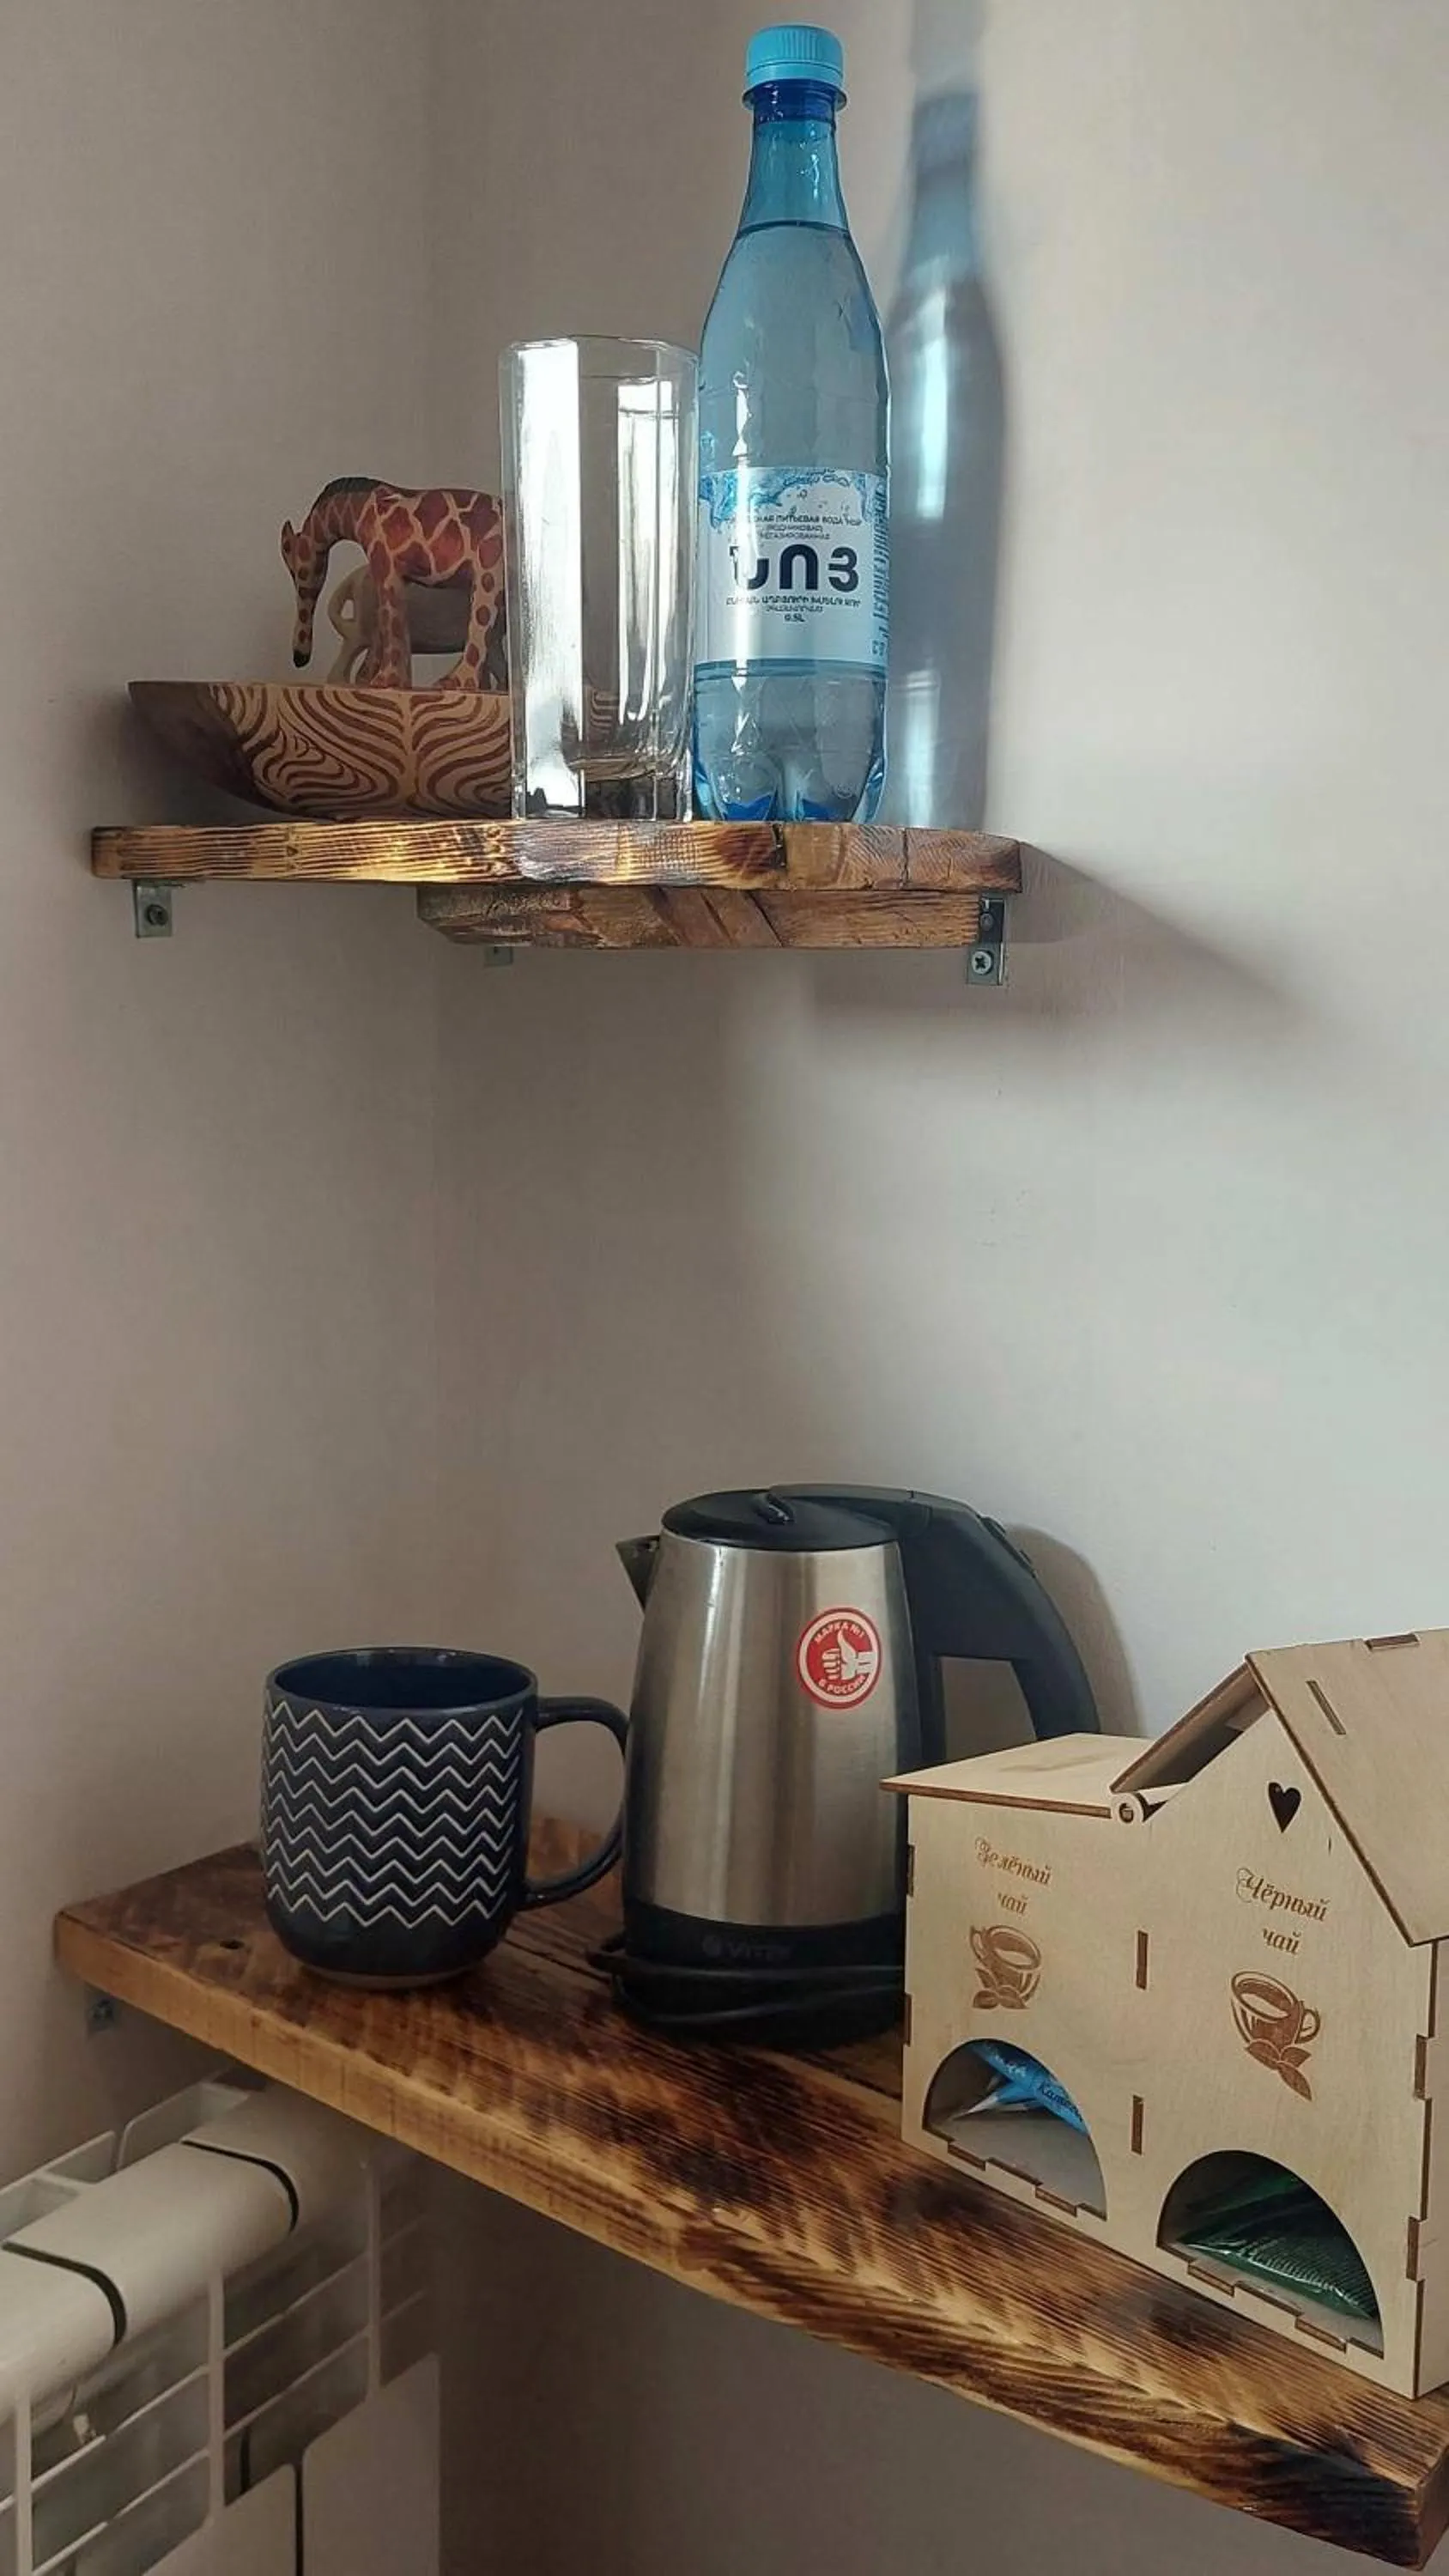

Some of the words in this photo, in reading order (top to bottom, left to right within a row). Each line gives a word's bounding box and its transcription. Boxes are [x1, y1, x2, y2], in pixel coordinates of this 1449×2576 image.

[975, 1836, 1052, 1885] Зелёный
[997, 1892, 1029, 1914] чай
[1236, 1868, 1331, 1922] Чёрный
[1263, 1928, 1301, 1955] чай
